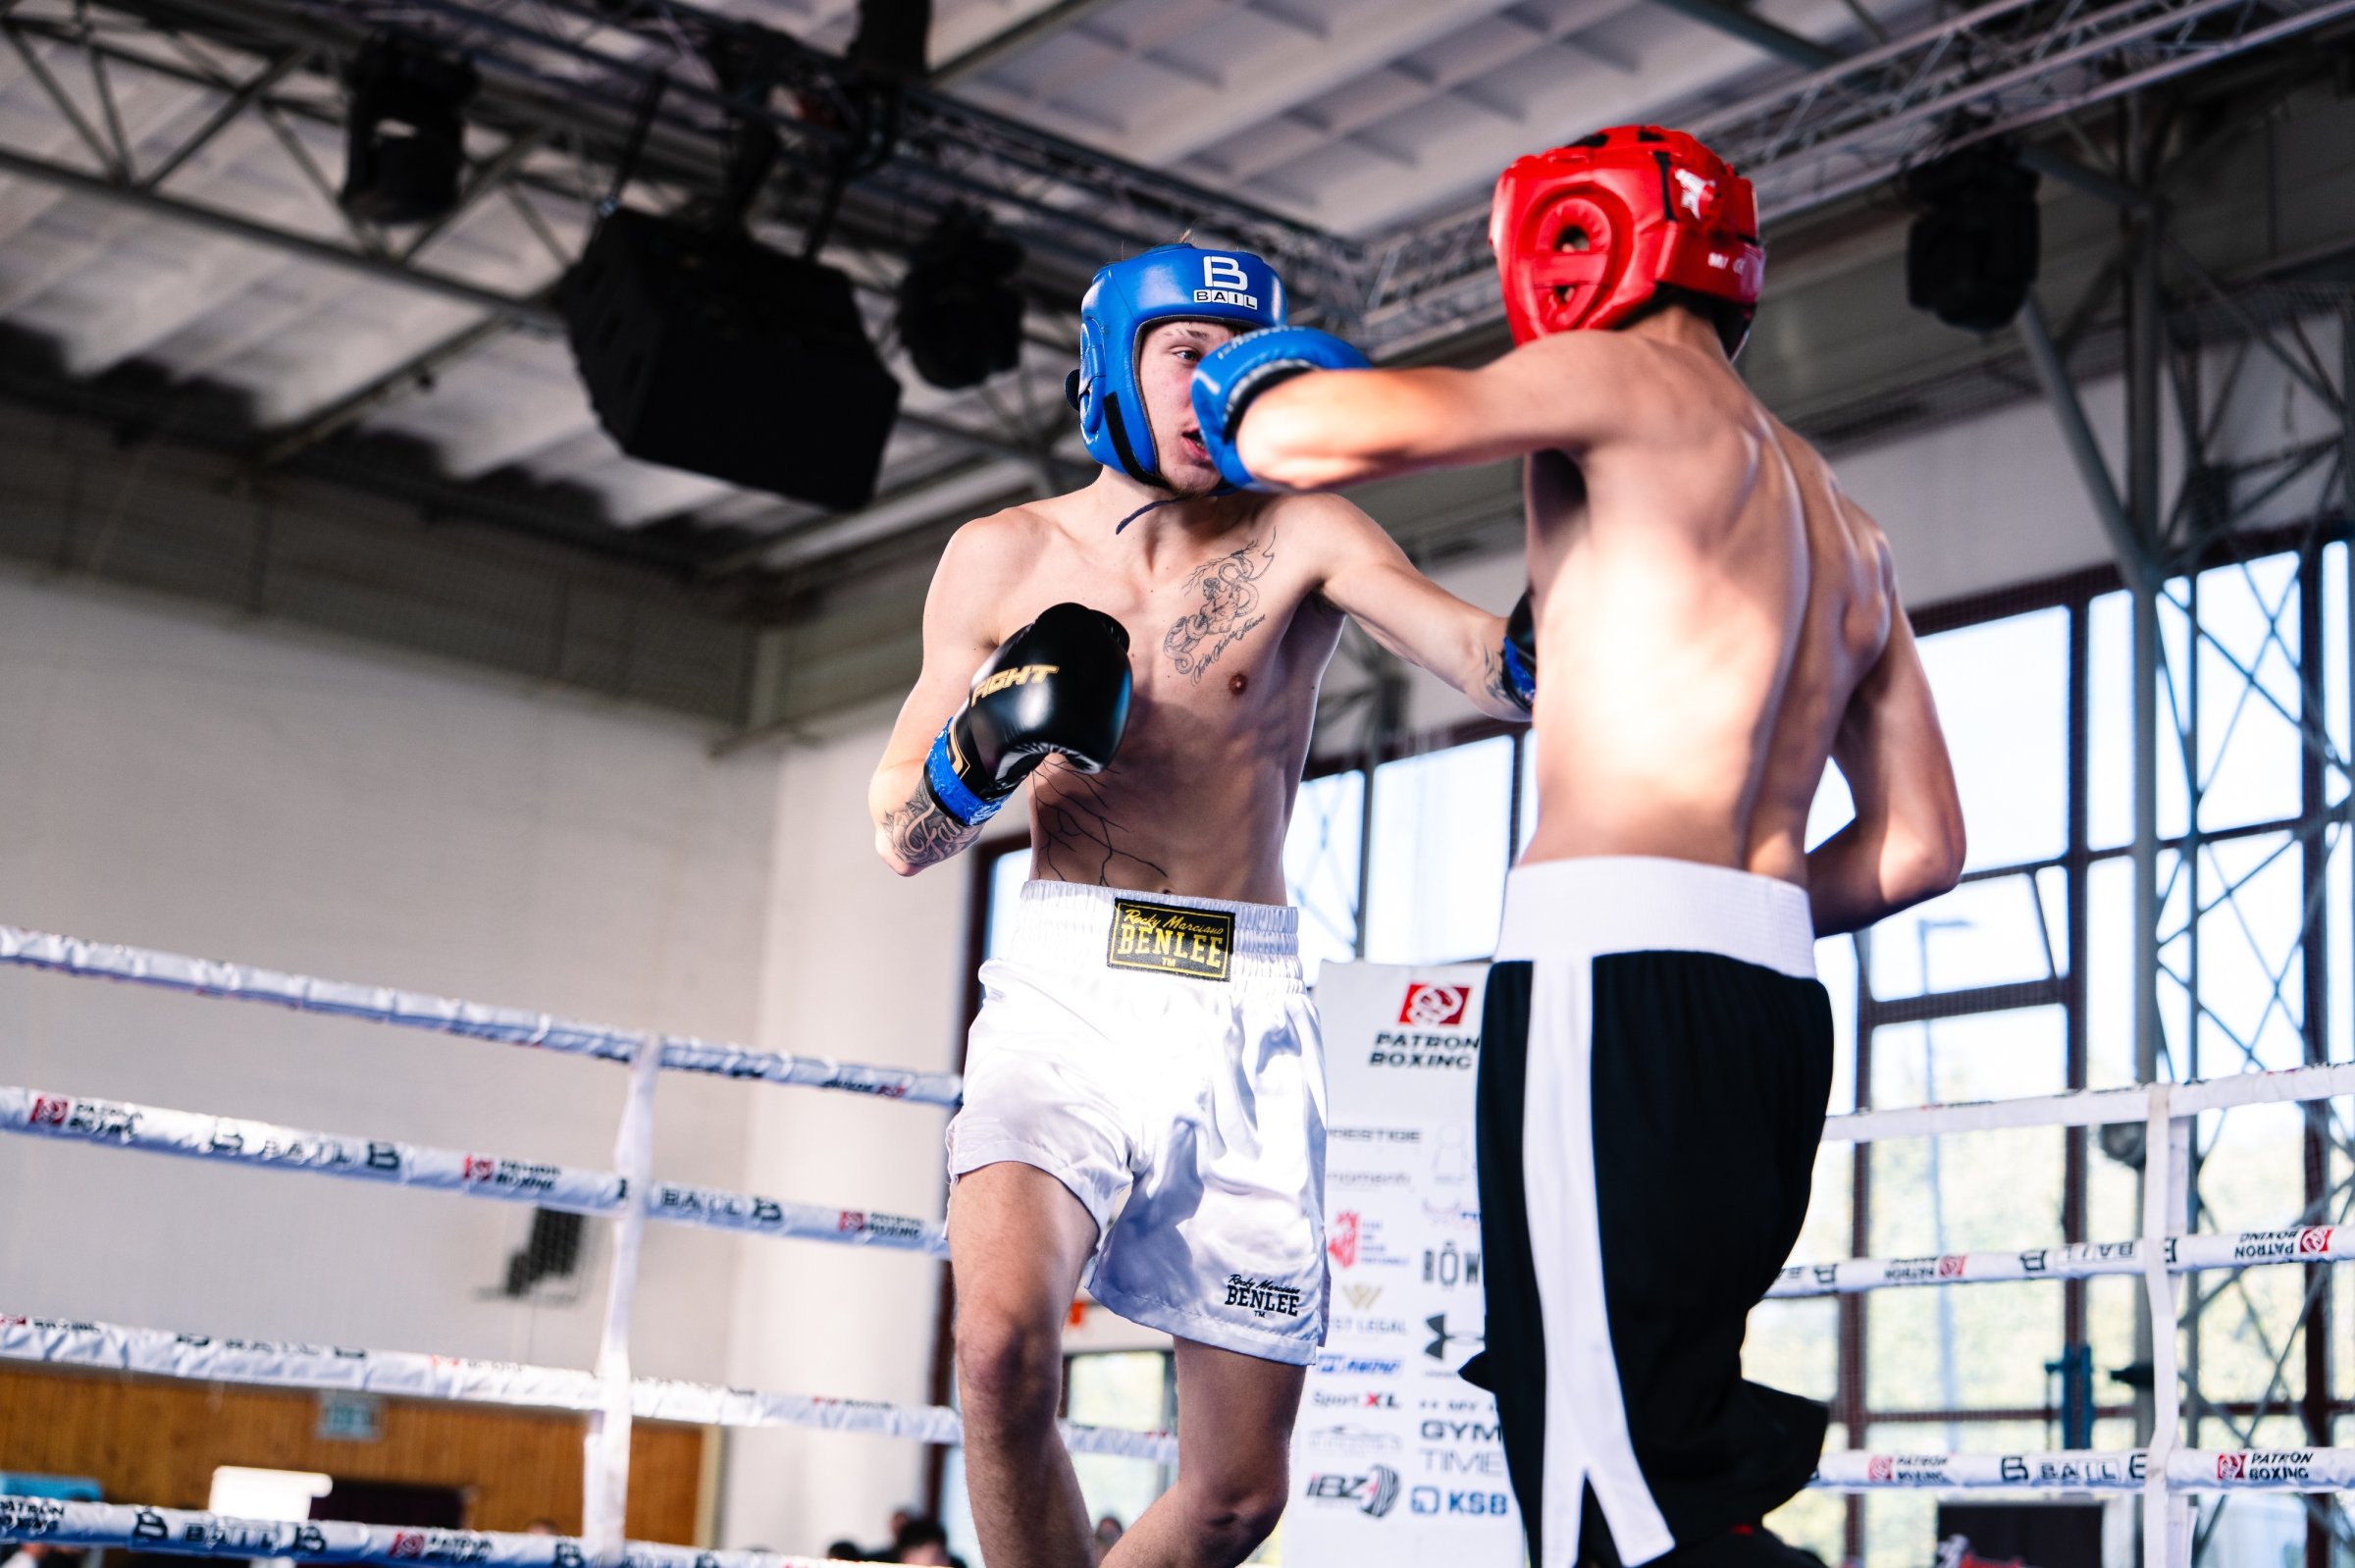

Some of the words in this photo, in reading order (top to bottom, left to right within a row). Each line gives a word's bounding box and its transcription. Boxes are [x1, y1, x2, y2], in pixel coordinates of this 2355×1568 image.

[1203, 255, 1248, 291] B
[1194, 289, 1257, 310] BAIL
[970, 664, 1060, 707] FIGHT
[1124, 909, 1162, 929] Rocky
[1162, 915, 1225, 935] Marciano
[1117, 923, 1224, 968] BENLEE
[1376, 1032, 1480, 1050] PATRON
[1368, 1052, 1474, 1070] BOXING
[2235, 1242, 2294, 1259] PATRON
[1229, 1274, 1256, 1289] Rocky
[1224, 1284, 1300, 1317] BENLEE
[1313, 1392, 1358, 1408] Sport
[1421, 1420, 1502, 1443] GYM
[1419, 1448, 1504, 1476] TIME
[2250, 1452, 2315, 1465] PATRON
[2039, 1461, 2119, 1481] BAIL
[2249, 1468, 2310, 1481] BOXING
[1448, 1492, 1508, 1515] KSB
